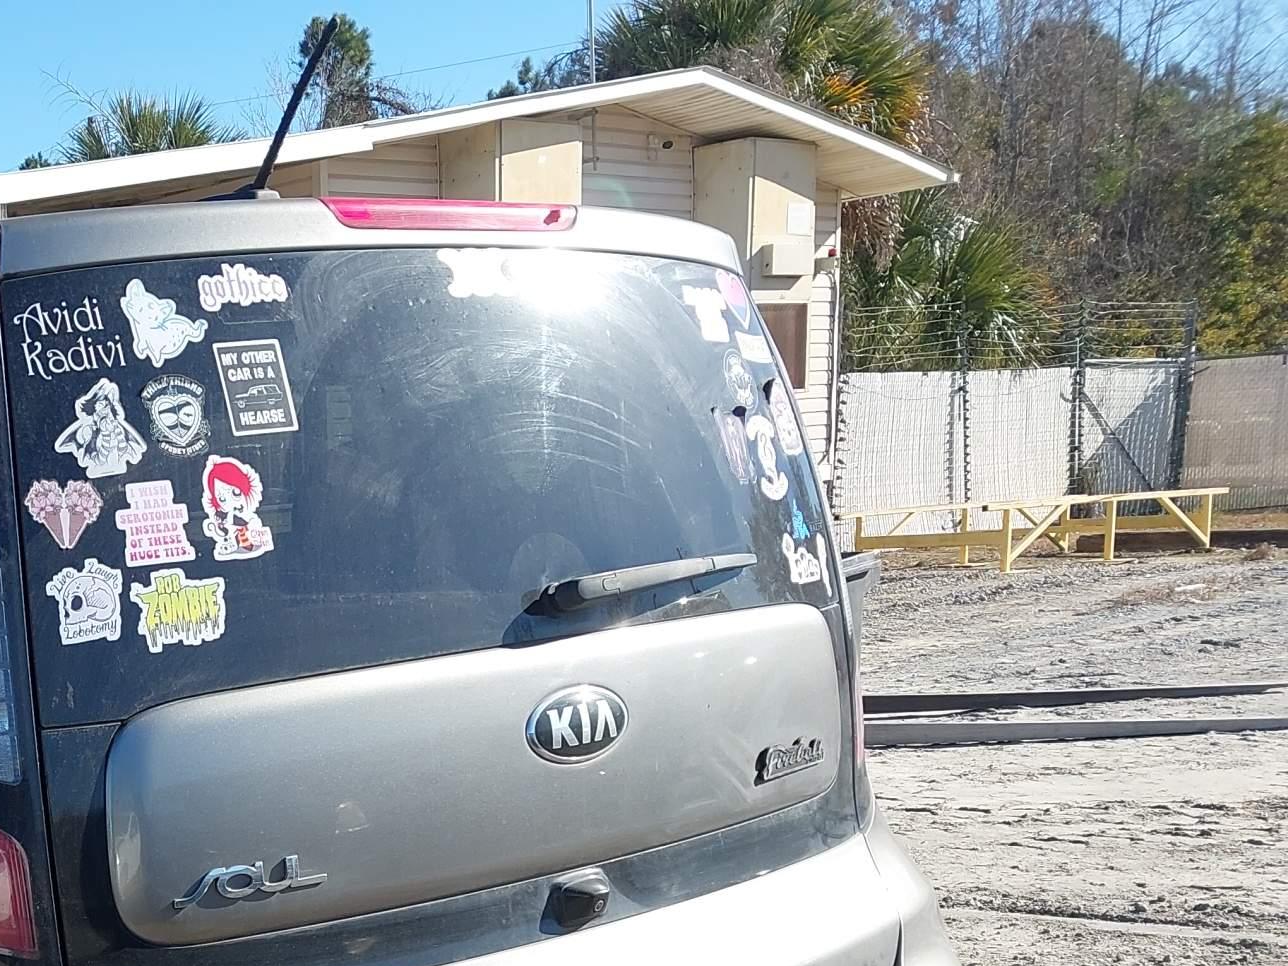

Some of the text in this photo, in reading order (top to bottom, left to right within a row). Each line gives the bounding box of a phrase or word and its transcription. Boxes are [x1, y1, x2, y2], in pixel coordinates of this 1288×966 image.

[201, 266, 284, 308] gothicc
[13, 296, 105, 343] Avidi
[220, 350, 277, 367] MY OTHER
[227, 365, 276, 382] CAR IS A
[239, 408, 287, 426] HEARSE
[139, 485, 169, 497] WISH
[143, 498, 168, 509] HAD
[119, 508, 184, 525] SEROTONIN
[129, 522, 178, 537] INSTEAD
[130, 534, 183, 549] OF THESE
[129, 546, 191, 562] HUGE TITS.
[49, 561, 119, 594] Live Laugh
[154, 573, 181, 595] ROB
[135, 582, 221, 640] ZOMBIE
[63, 618, 118, 640] Lobotomy
[546, 698, 620, 751] KIA
[173, 853, 328, 910] SOUL
